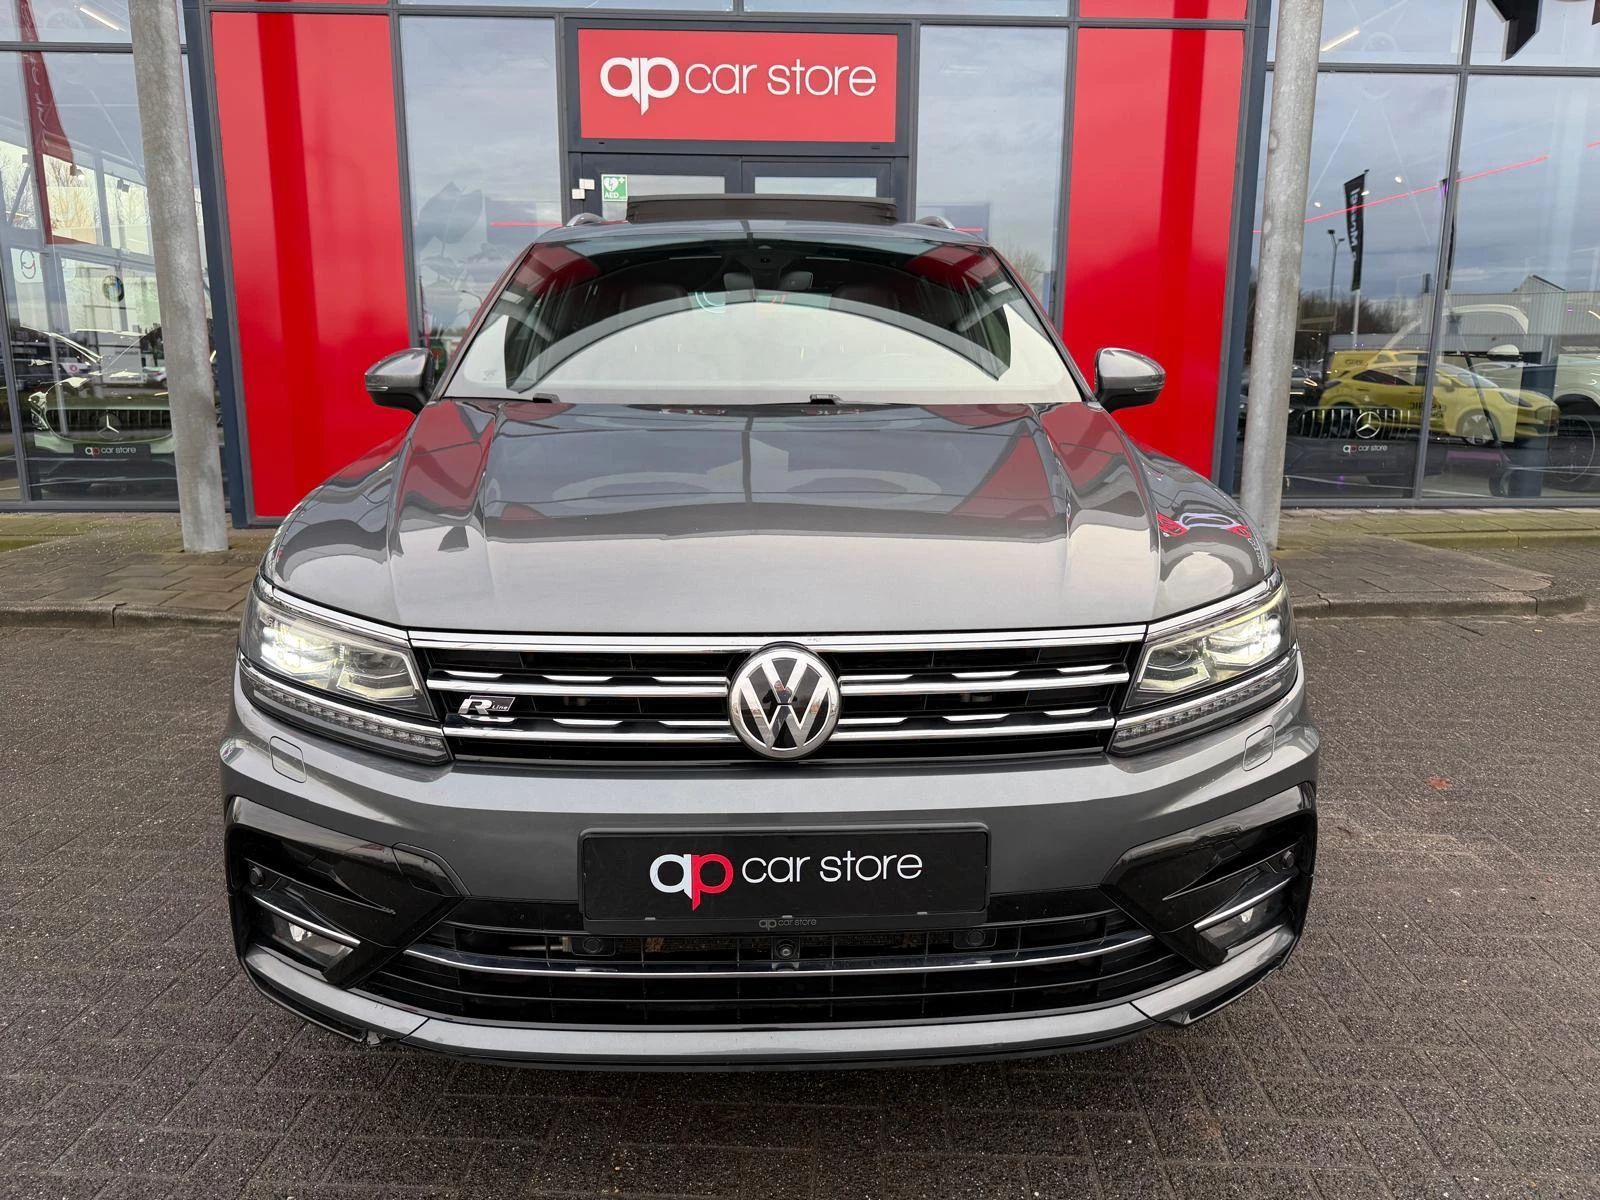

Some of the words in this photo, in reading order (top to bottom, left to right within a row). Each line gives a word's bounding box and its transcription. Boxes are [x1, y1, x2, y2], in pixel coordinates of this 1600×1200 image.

[600, 56, 679, 116] ap
[685, 63, 757, 94] car
[767, 58, 877, 96] store
[458, 698, 492, 714] R
[650, 854, 734, 910] ap
[742, 857, 811, 883] car
[819, 850, 923, 882] store
[758, 919, 777, 931] ap
